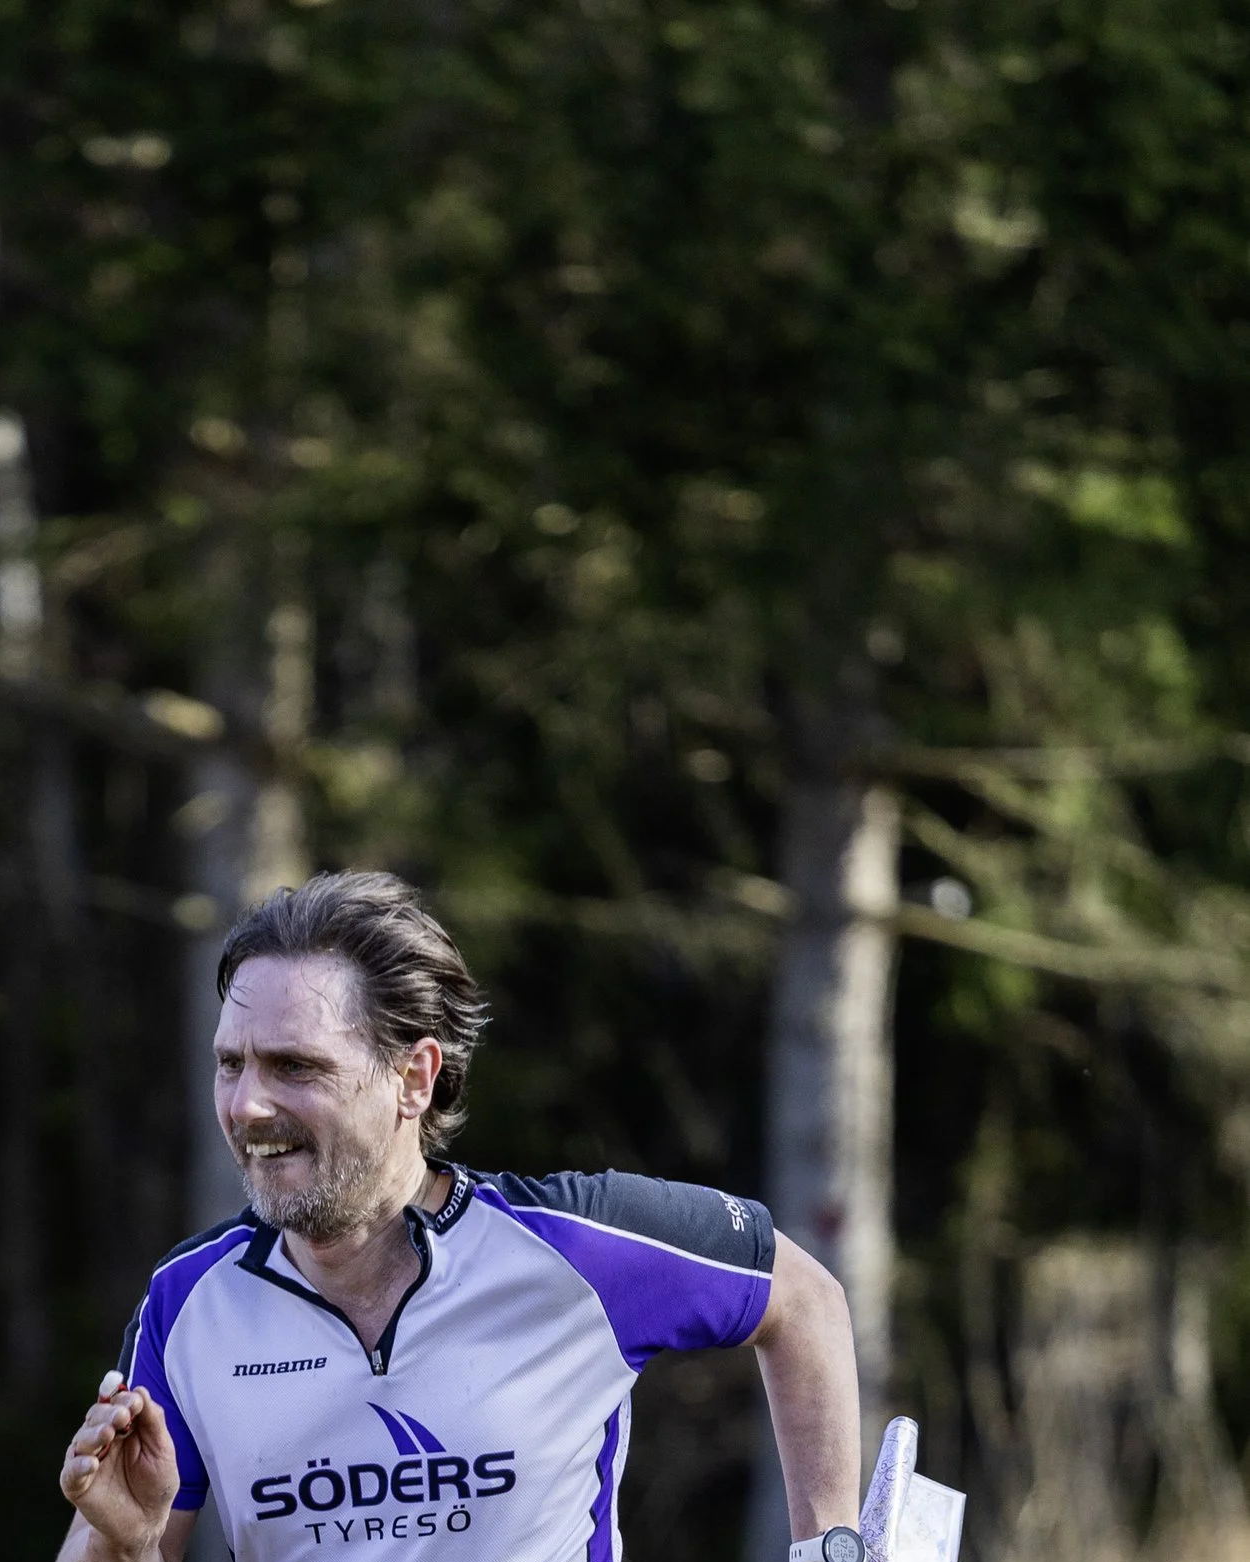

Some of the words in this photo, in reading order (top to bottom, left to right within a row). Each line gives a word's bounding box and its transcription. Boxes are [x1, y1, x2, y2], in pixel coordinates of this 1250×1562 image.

[232, 1356, 328, 1377] noname
[250, 1450, 517, 1521] SÖDERS
[305, 1504, 472, 1545] TYRESÖ
